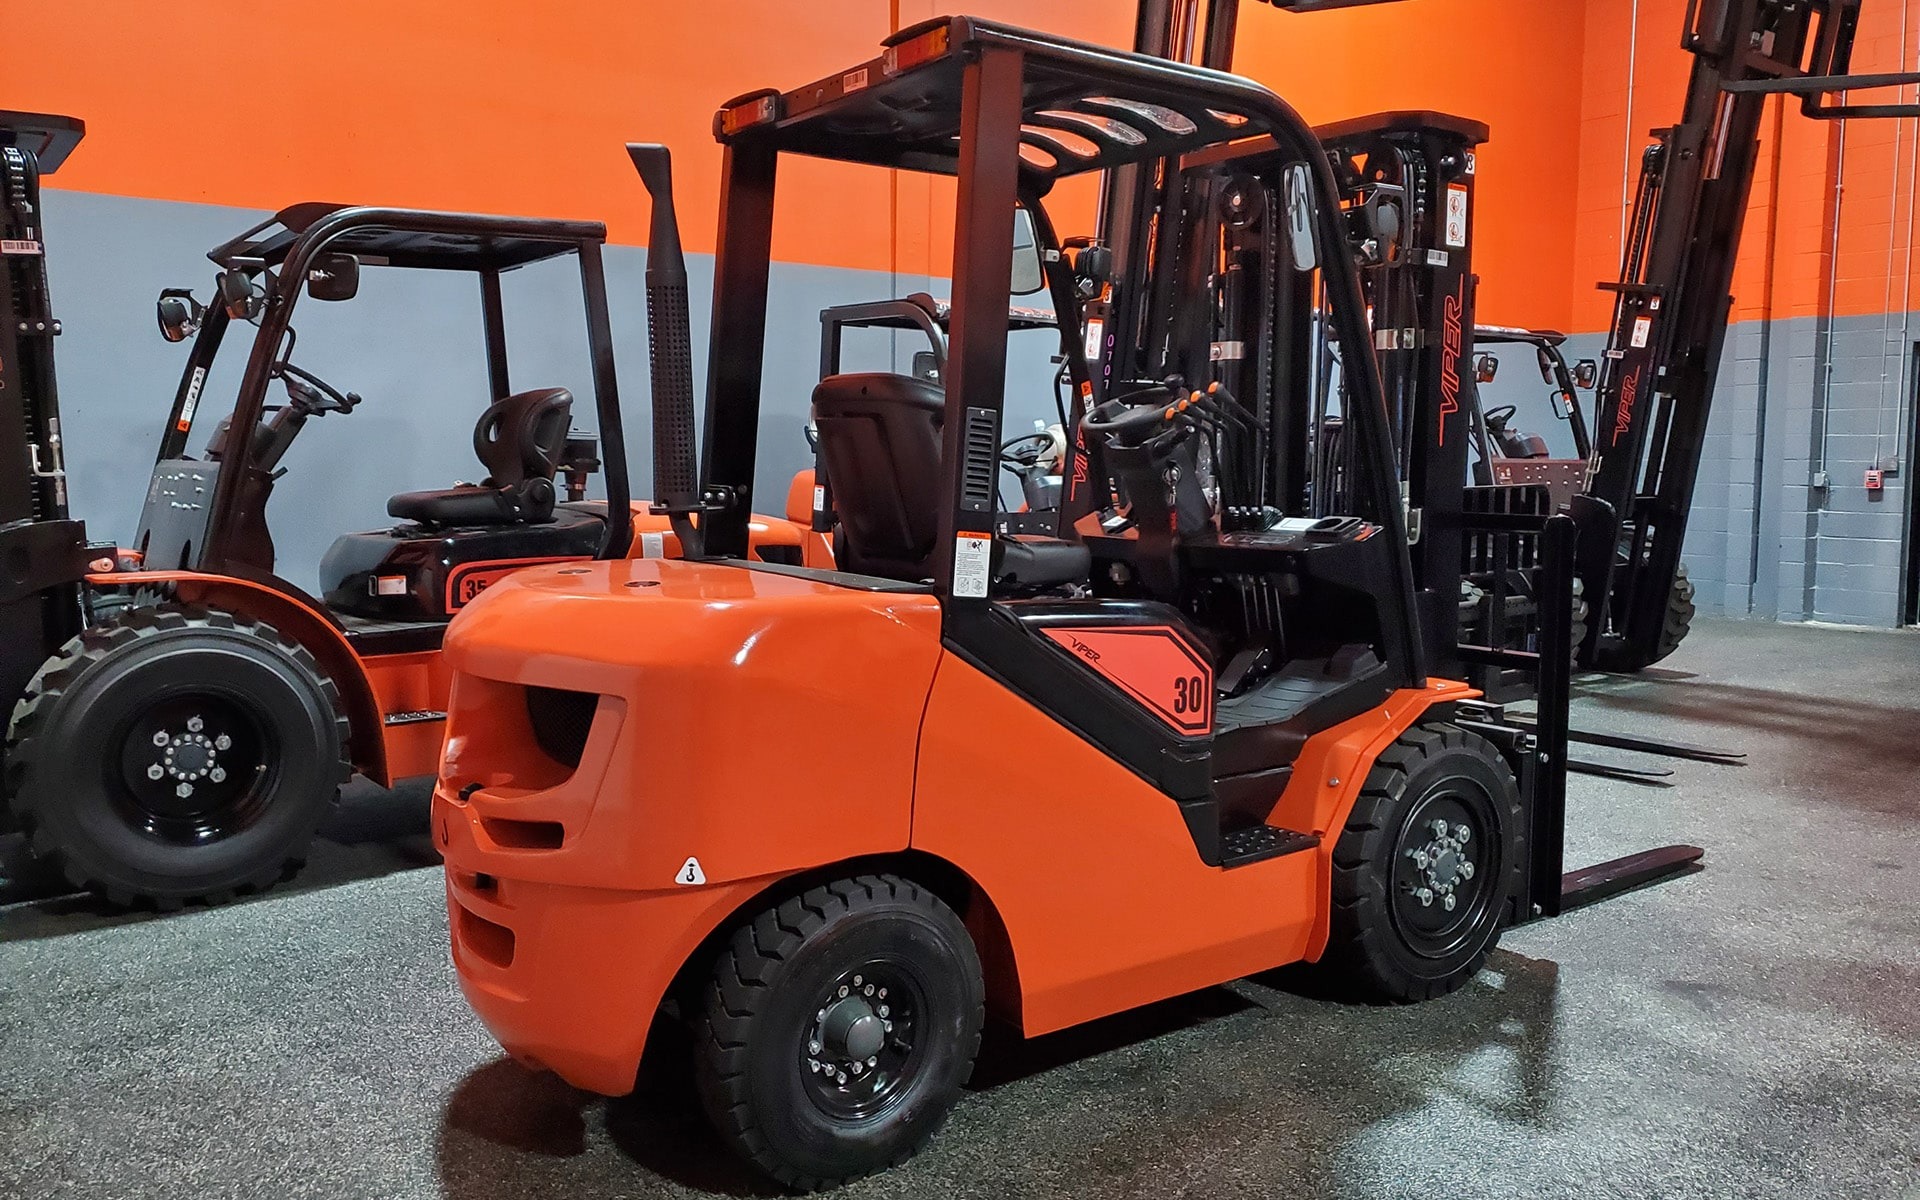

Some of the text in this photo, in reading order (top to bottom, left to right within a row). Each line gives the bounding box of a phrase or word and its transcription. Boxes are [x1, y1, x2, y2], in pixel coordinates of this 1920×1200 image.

[1438, 273, 1466, 446] VIPER
[1612, 365, 1641, 447] VIPER
[1067, 633, 1102, 664] VIPER
[1174, 676, 1202, 714] 30
